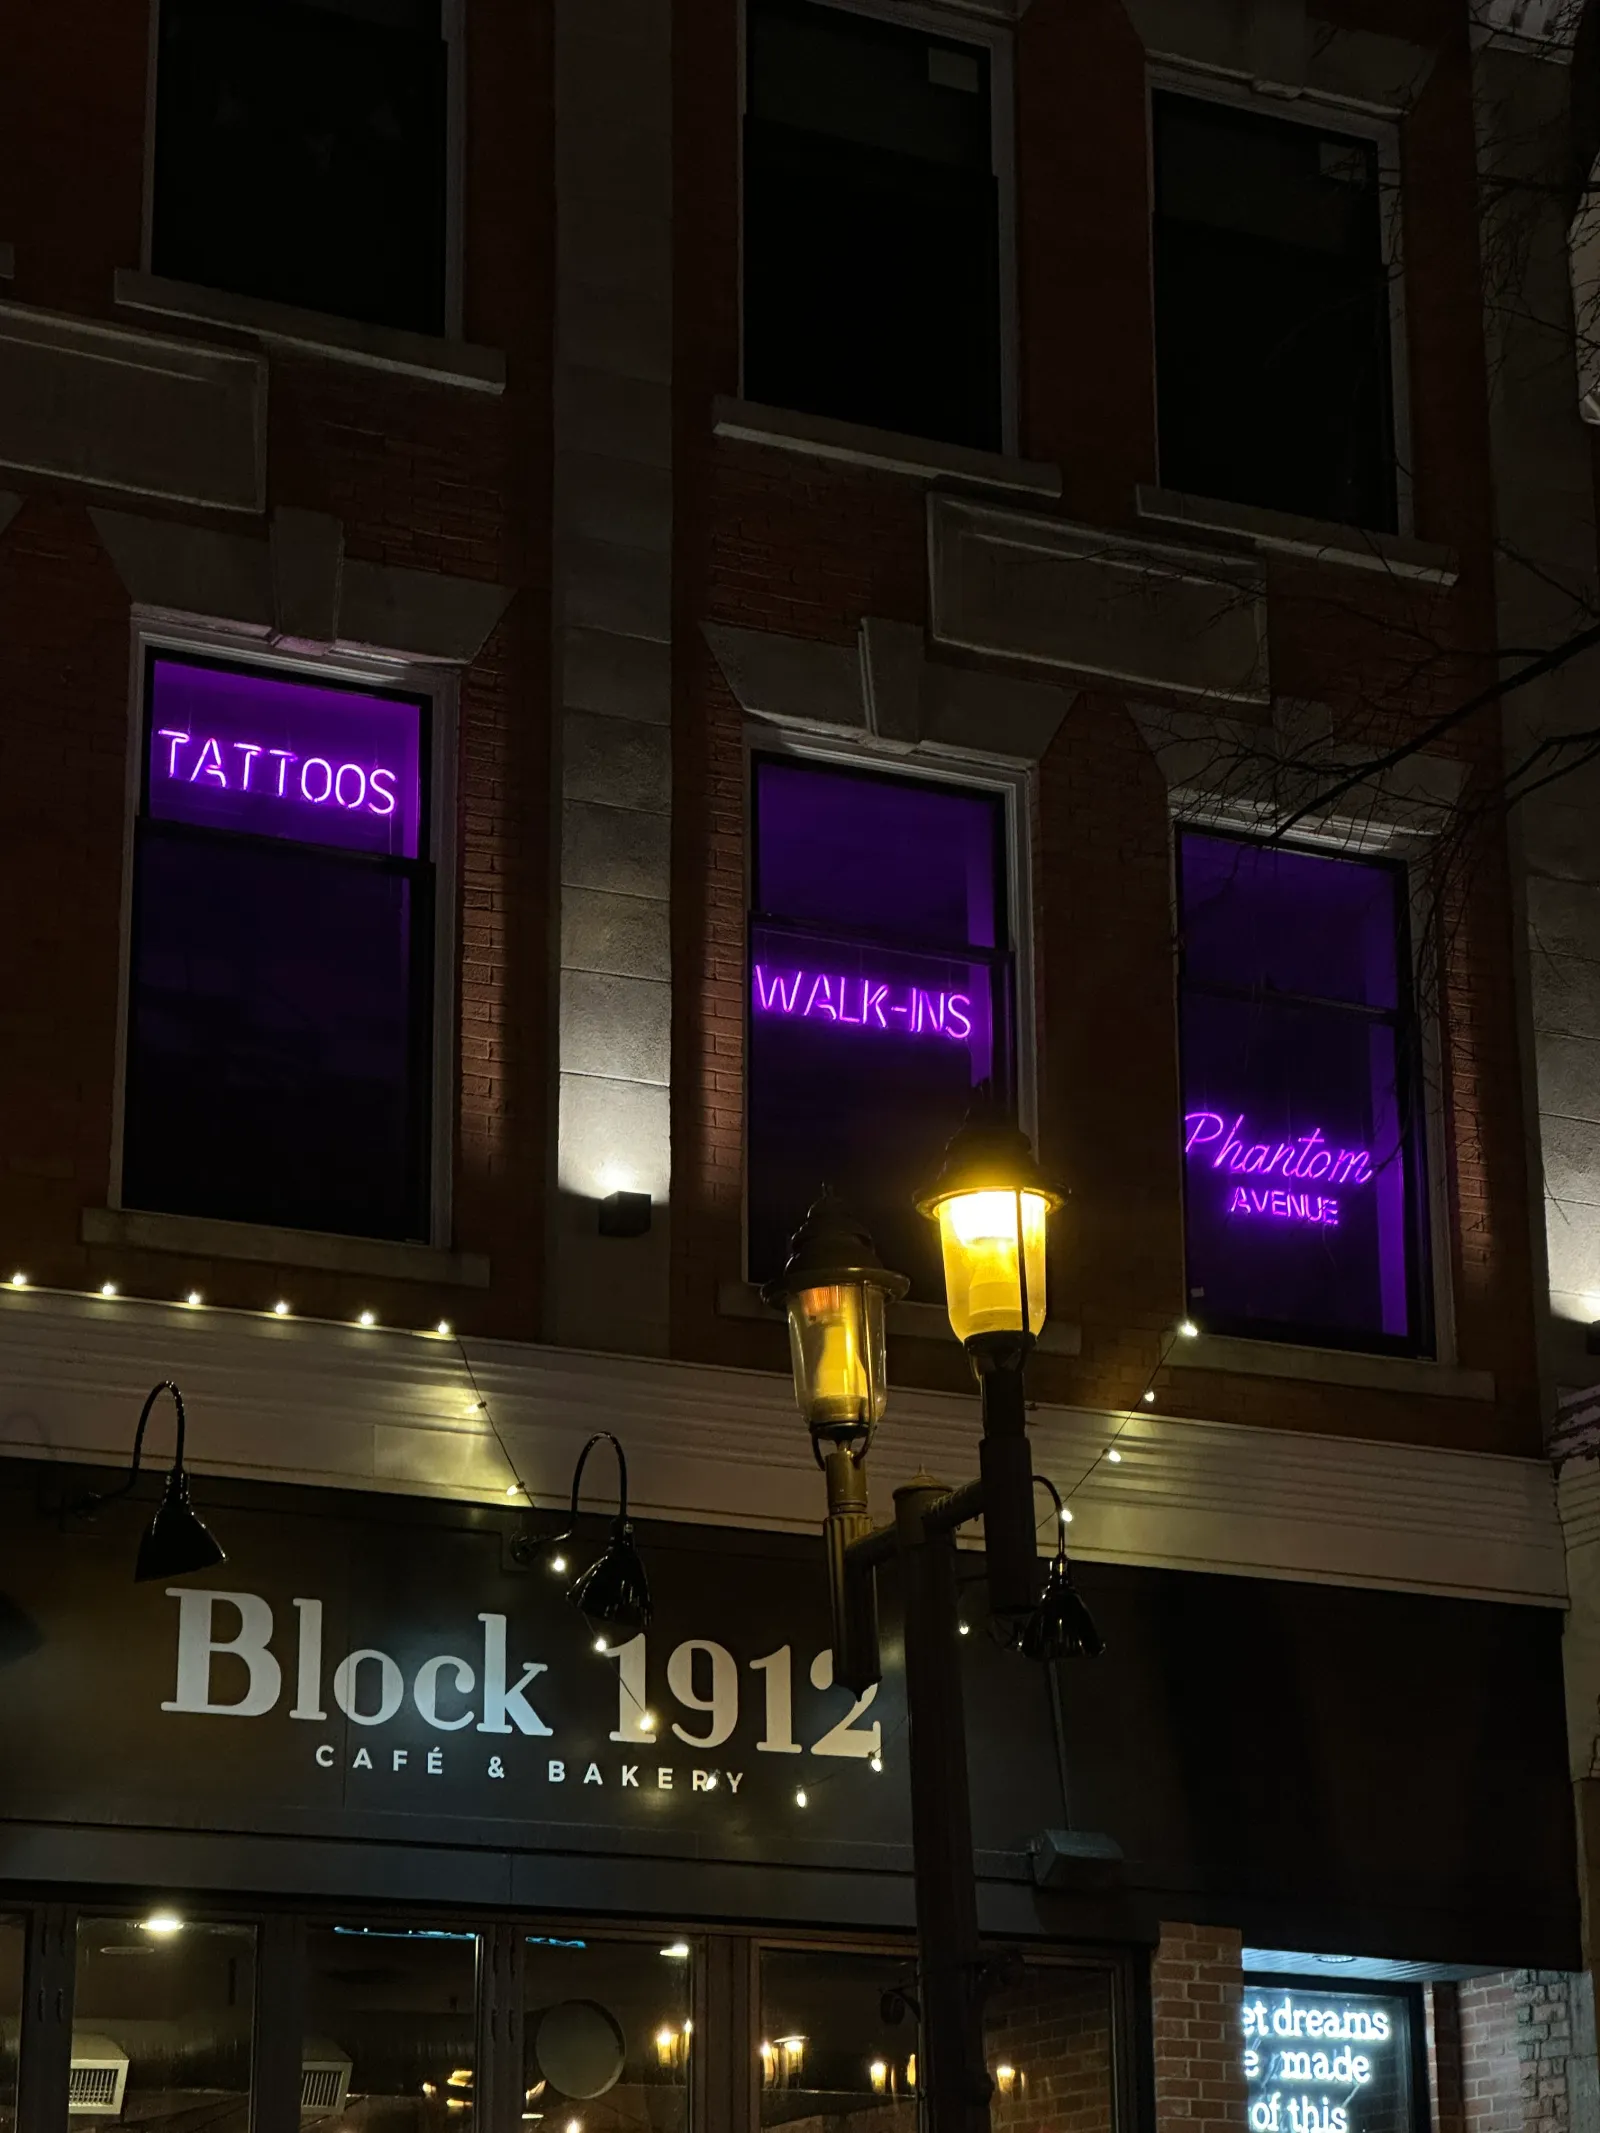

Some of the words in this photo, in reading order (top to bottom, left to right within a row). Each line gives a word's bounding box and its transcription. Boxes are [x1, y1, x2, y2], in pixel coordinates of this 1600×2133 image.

[158, 729, 396, 814] TATTOOS
[755, 965, 971, 1039] WALK-INS
[1185, 1112, 1373, 1184] Phantom
[1229, 1186, 1339, 1225] AVENUE
[160, 1587, 554, 1737] Block
[608, 1632, 883, 1758] 1912
[315, 1744, 443, 1775] CAFÉ
[487, 1756, 505, 1779] &
[548, 1760, 743, 1793] BAKERY
[1272, 1998, 1390, 2040] dreams
[1280, 2047, 1371, 2083] made
[1252, 2092, 1281, 2131] of
[1287, 2097, 1348, 2133] this
